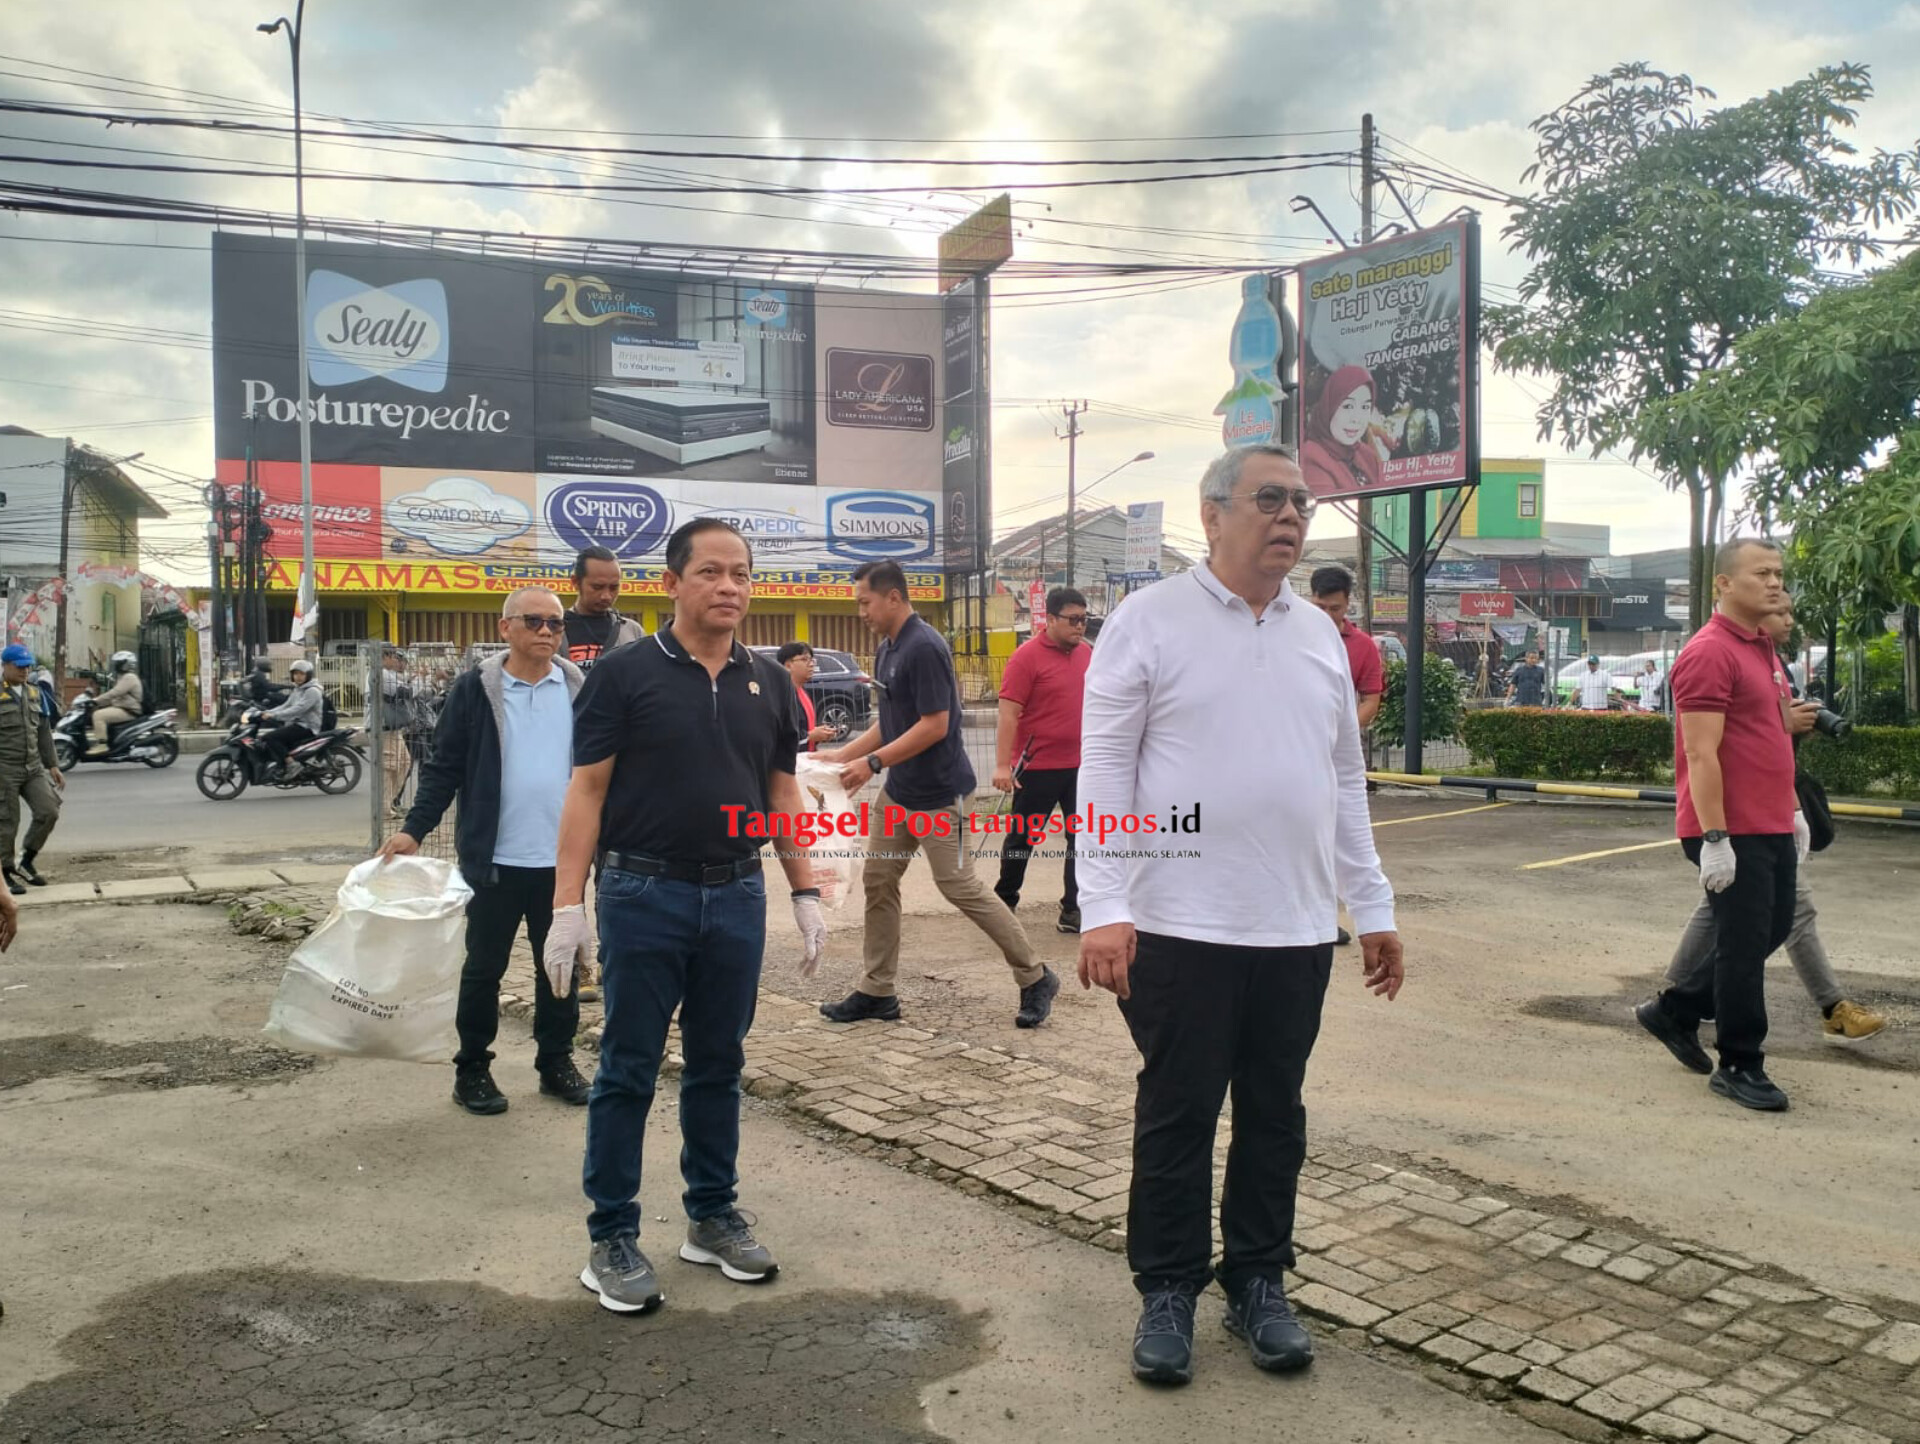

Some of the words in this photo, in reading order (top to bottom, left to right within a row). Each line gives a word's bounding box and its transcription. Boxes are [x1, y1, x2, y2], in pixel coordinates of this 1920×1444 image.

[1311, 272, 1353, 300] sate
[1357, 243, 1453, 289] maranggi
[749, 298, 780, 317] Sealy
[1330, 291, 1370, 323] Haji
[1374, 280, 1429, 312] Yetty
[326, 304, 427, 358] Sealy
[1391, 319, 1451, 343] CABANG
[1365, 338, 1451, 368] TANGERANG
[240, 378, 511, 440] Posturepedic
[906, 404, 925, 412] USA
[407, 506, 501, 523] COMFORTA
[573, 496, 647, 518] SPRING
[593, 517, 628, 536] AIR
[839, 518, 924, 535] SIMMONS
[264, 562, 480, 590] ANAMAS
[792, 585, 848, 597] CLASS
[331, 994, 369, 1013] EXPIRED
[370, 1008, 394, 1020] DATE
